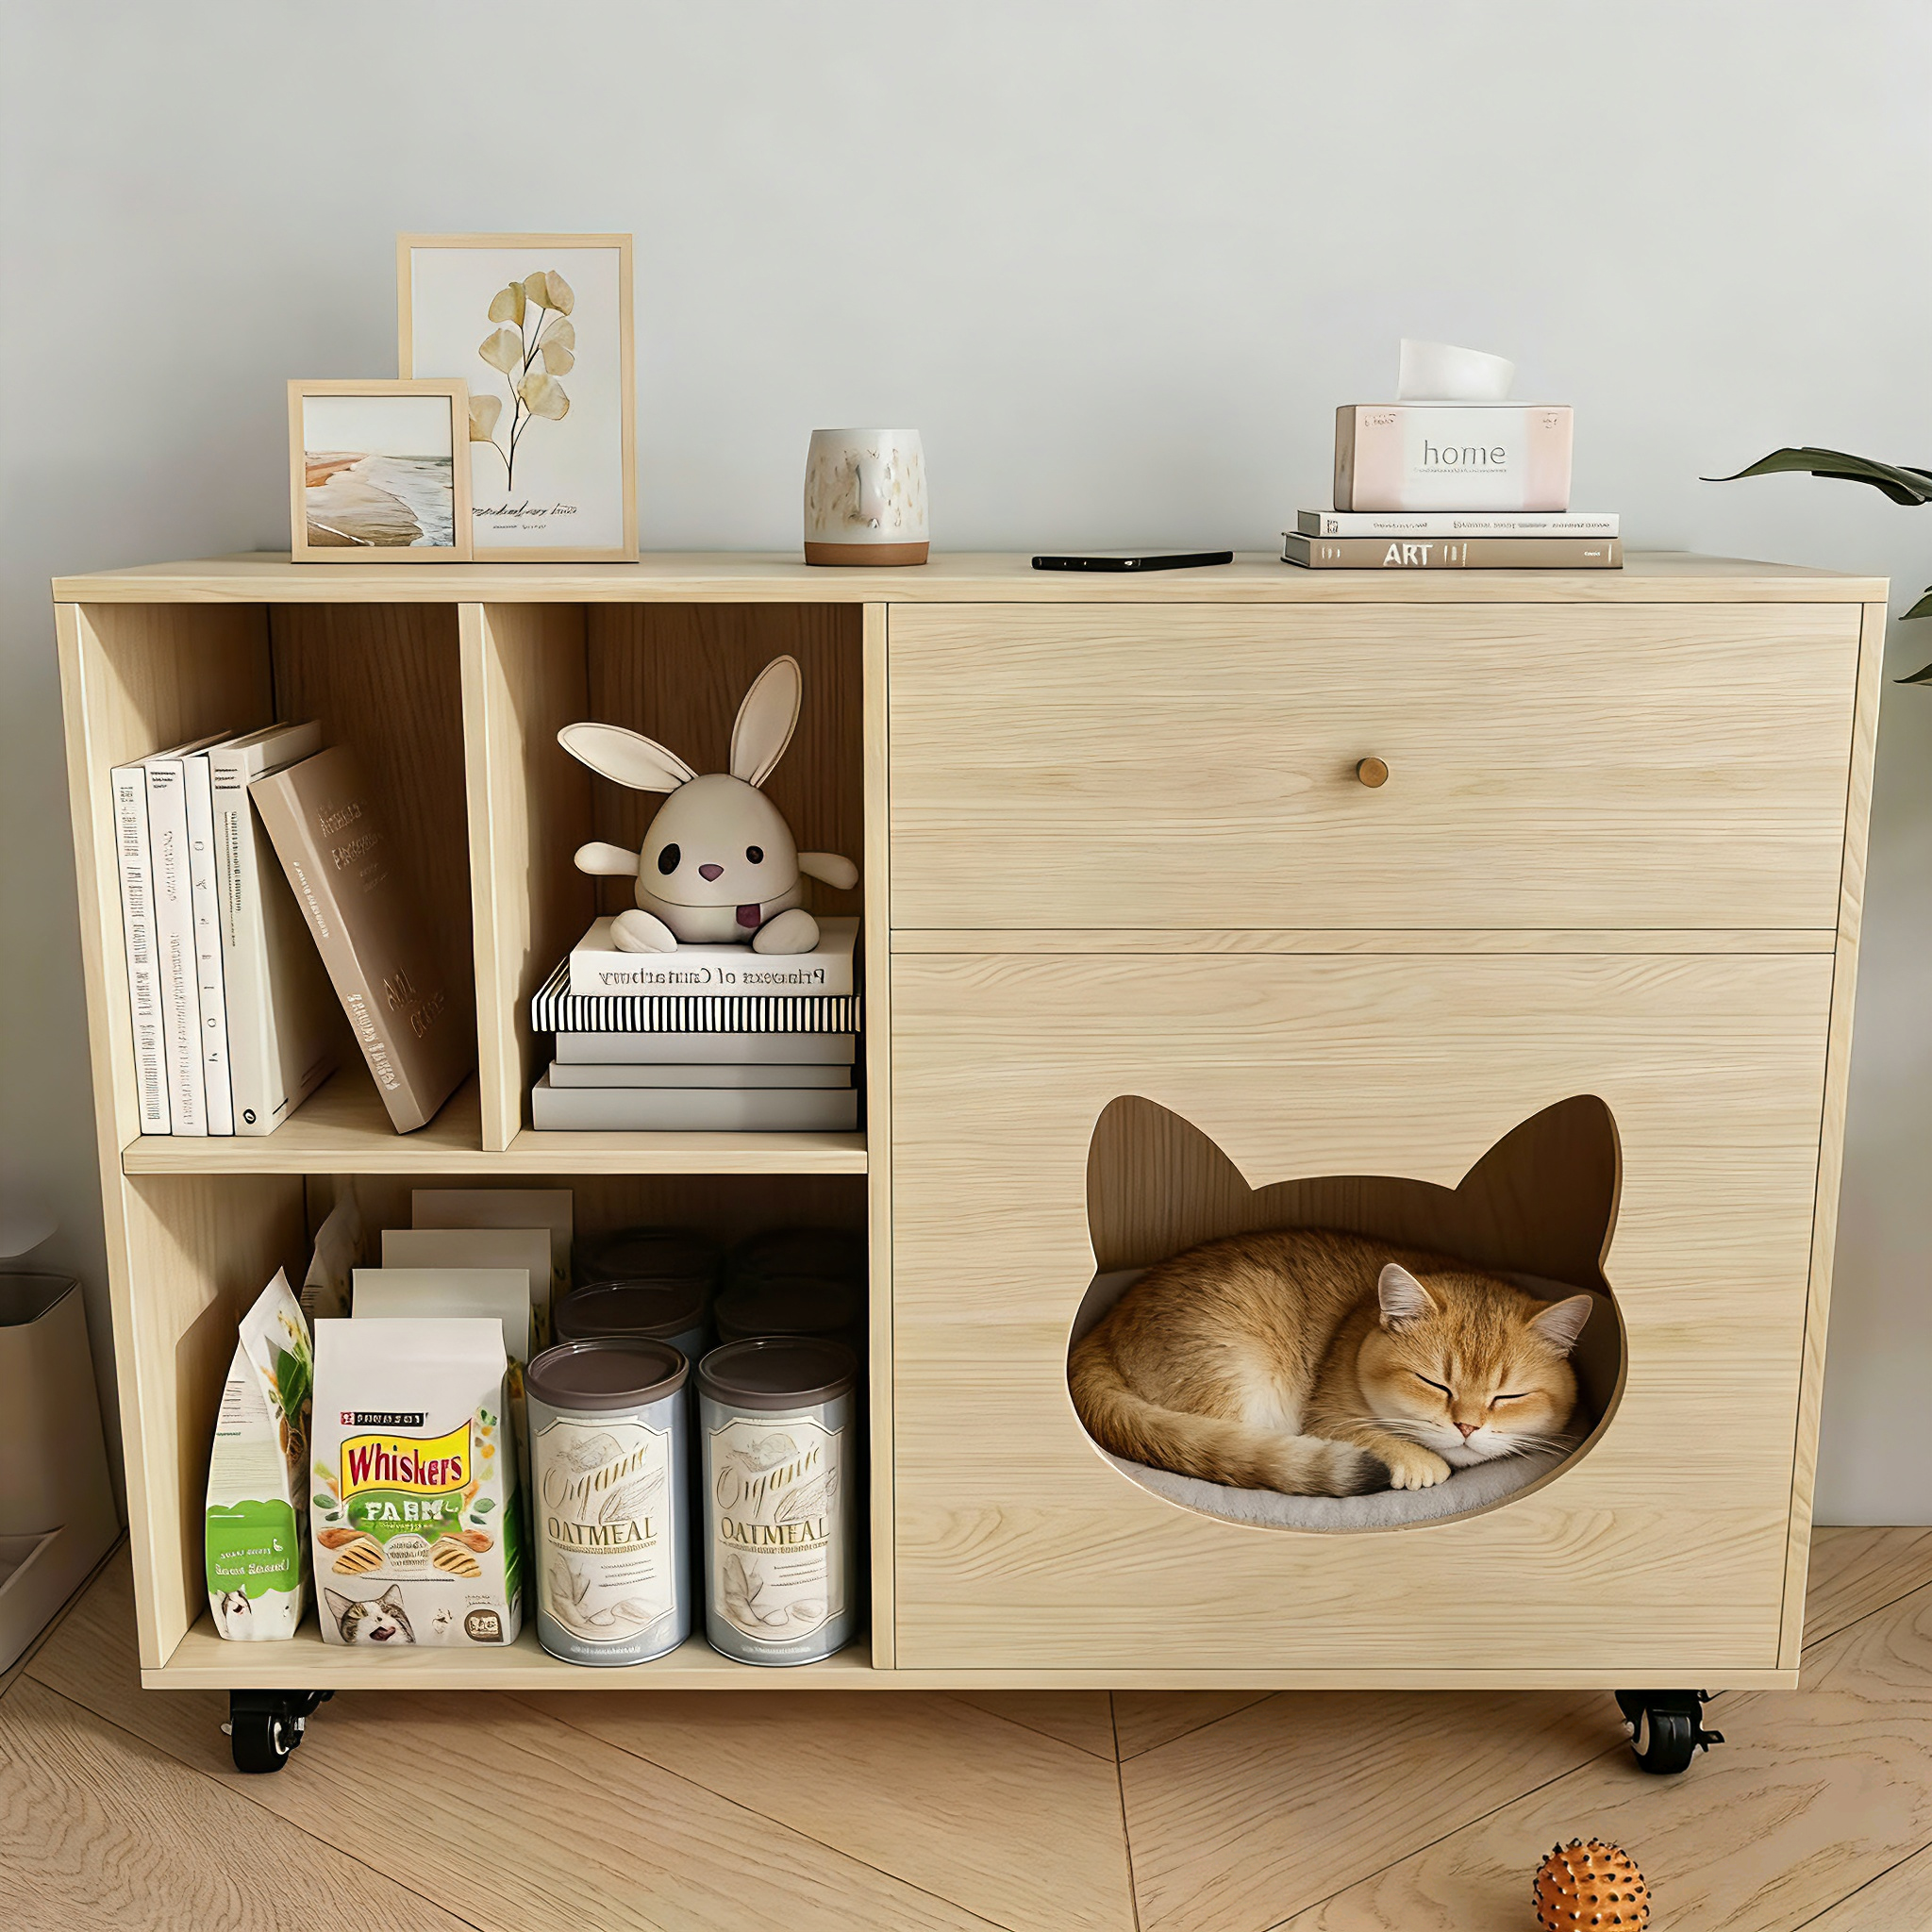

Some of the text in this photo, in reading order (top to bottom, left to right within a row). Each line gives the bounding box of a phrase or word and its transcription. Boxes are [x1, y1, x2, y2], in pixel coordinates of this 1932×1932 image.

[1424, 439, 1507, 465] home
[1383, 542, 1434, 566] ART
[348, 1442, 462, 1487] Whiskers
[547, 1516, 658, 1546] OATMEAL
[721, 1516, 831, 1545] OATMEAL
